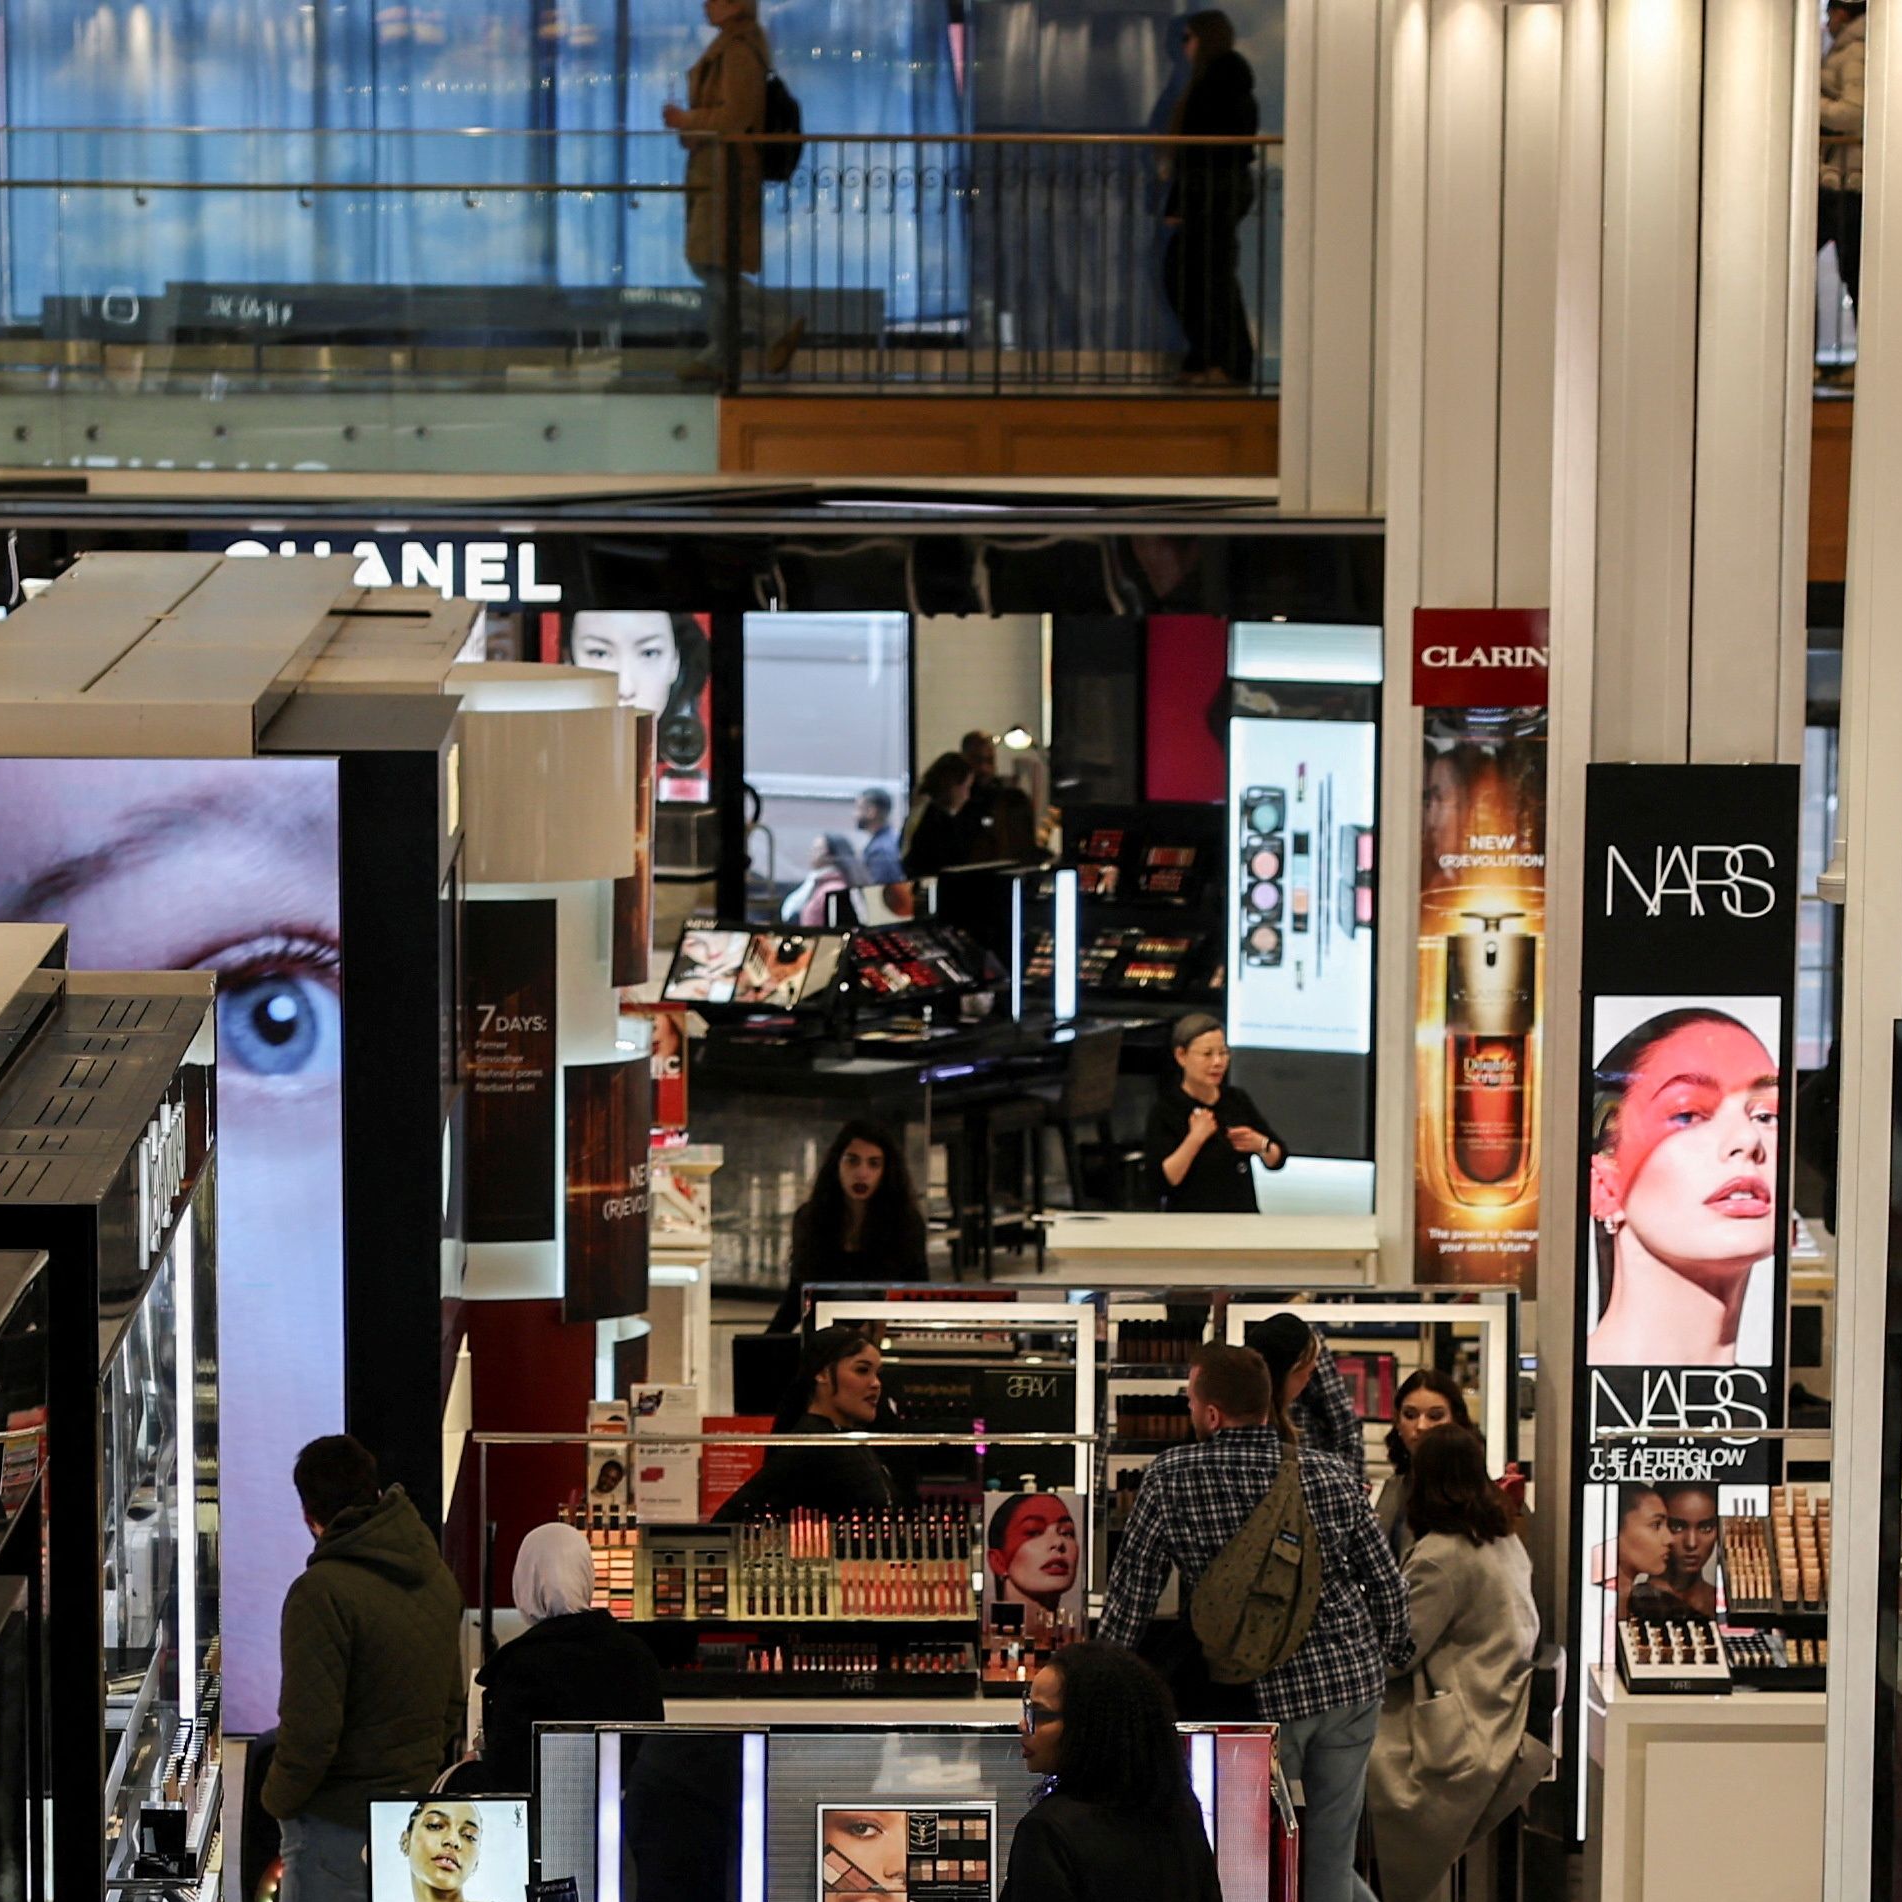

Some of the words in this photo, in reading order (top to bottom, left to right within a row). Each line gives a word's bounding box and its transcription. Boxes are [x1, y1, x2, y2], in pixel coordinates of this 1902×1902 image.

[225, 539, 562, 602] ANEL
[1469, 834, 1517, 851] NEW
[1606, 843, 1776, 919] NARS
[476, 1004, 497, 1032] 7
[495, 1015, 548, 1032] DAYS:
[1428, 1228, 1449, 1239] The
[1450, 1229, 1486, 1241] power
[1487, 1229, 1499, 1239] to
[1438, 1243, 1464, 1254] your
[1466, 1242, 1495, 1253] skin's
[1498, 1242, 1532, 1252] future
[1589, 1368, 1768, 1446] NARS
[1589, 1447, 1628, 1466] THE
[1630, 1447, 1747, 1466] AFTERGLOW
[1589, 1463, 1713, 1481] COLLECTION
